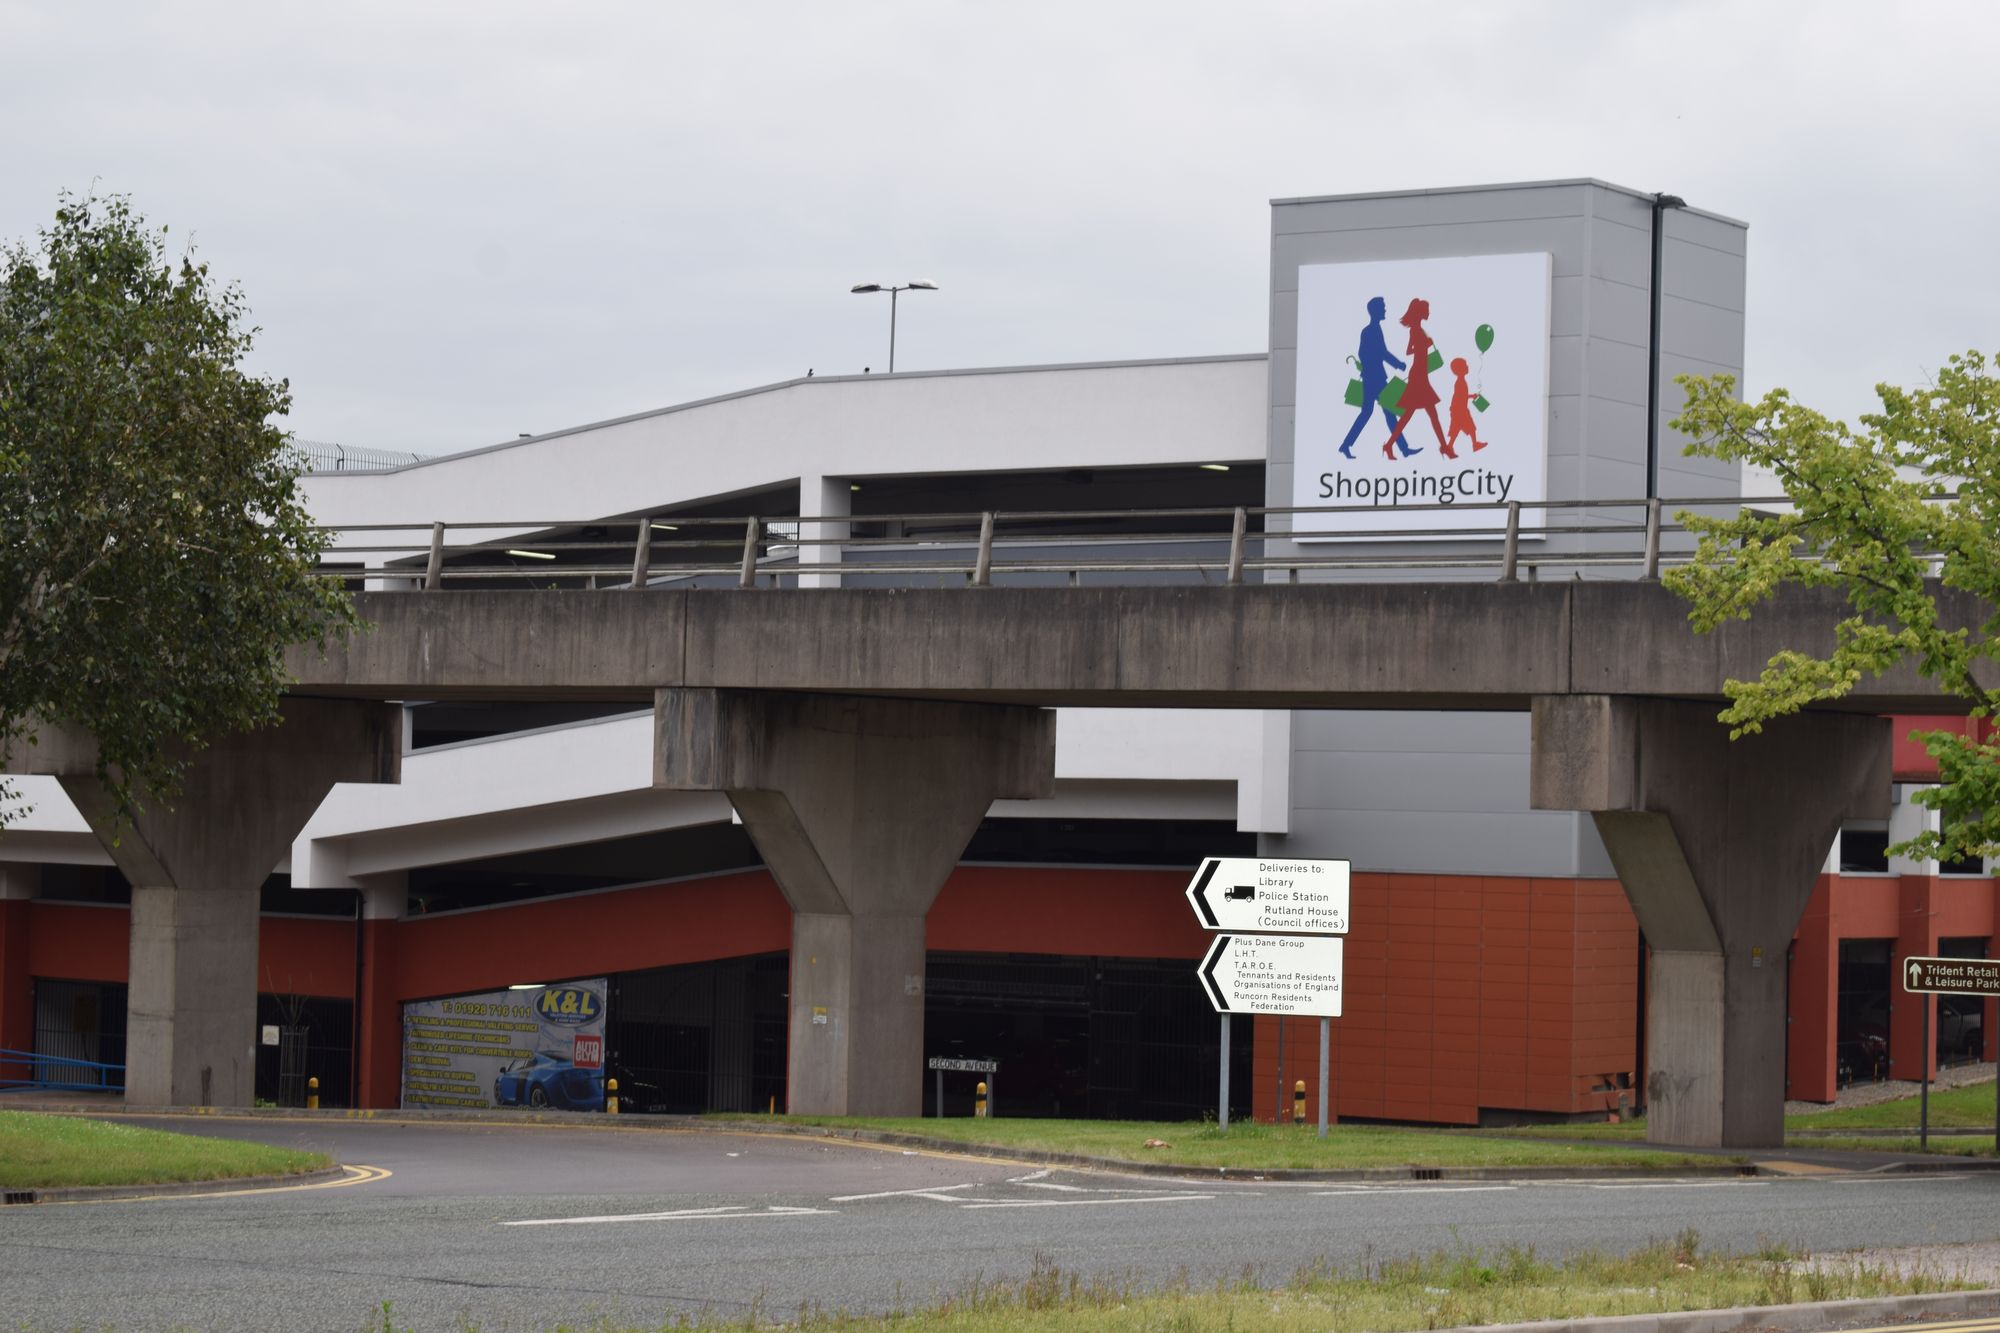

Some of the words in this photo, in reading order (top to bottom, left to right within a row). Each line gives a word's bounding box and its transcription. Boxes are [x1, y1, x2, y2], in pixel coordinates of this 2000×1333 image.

[1319, 468, 1514, 506] ShoppingCity
[1259, 863, 1308, 873] Deliveries
[1311, 865, 1324, 874] to:
[1259, 877, 1294, 888] Library
[1259, 891, 1288, 900] Police
[1292, 892, 1329, 902] Station
[1265, 905, 1304, 915] Rutland
[1307, 907, 1338, 916] House
[1258, 916, 1301, 927] (Council
[1305, 918, 1345, 929] offices)
[1234, 938, 1253, 946] Plus
[1255, 939, 1276, 947] Dane
[1279, 939, 1305, 948] Group
[1234, 950, 1258, 958] L.H.T.
[1234, 961, 1276, 971] T.A.R.O.E.
[1926, 965, 1964, 976] Trident
[1967, 967, 1999, 977] Retail
[1237, 970, 1274, 979] Tennants
[1295, 973, 1336, 982] Residents
[1234, 980, 1291, 990] Organisations
[1305, 983, 1339, 992] England
[1924, 976, 1932, 986] &
[1935, 977, 1973, 988] Leisure
[1976, 978, 2000, 989] Park
[541, 990, 595, 1015] K&L
[1234, 991, 1268, 1000] Runcorn
[1271, 993, 1312, 1002] Residents
[442, 1001, 452, 1014] T:
[454, 1002, 487, 1016] 01928
[489, 1004, 510, 1017] 716
[513, 1006, 532, 1018] 111
[1250, 1002, 1295, 1011] Federation
[575, 1040, 600, 1052] AUTO
[930, 1058, 961, 1069] SECOND
[965, 1060, 996, 1072] AVENUE
